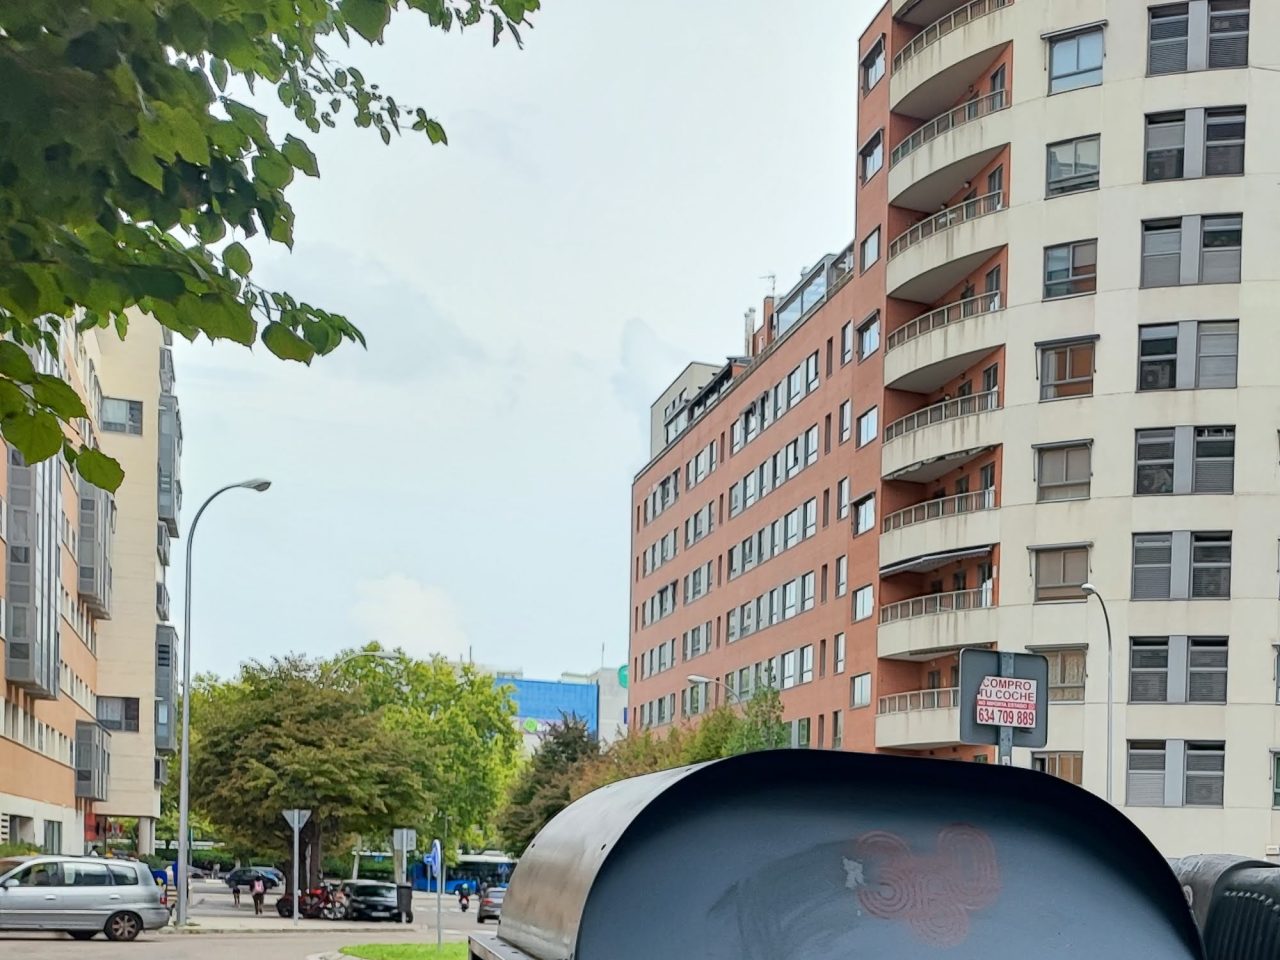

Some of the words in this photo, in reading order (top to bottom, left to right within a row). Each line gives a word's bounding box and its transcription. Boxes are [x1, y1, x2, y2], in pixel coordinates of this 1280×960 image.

[983, 678, 1031, 691] COMPRO
[980, 689, 992, 698] TU
[996, 690, 1034, 702] COCHE
[978, 708, 995, 723] 634
[998, 710, 1014, 724] 709
[1017, 711, 1034, 726] 889
